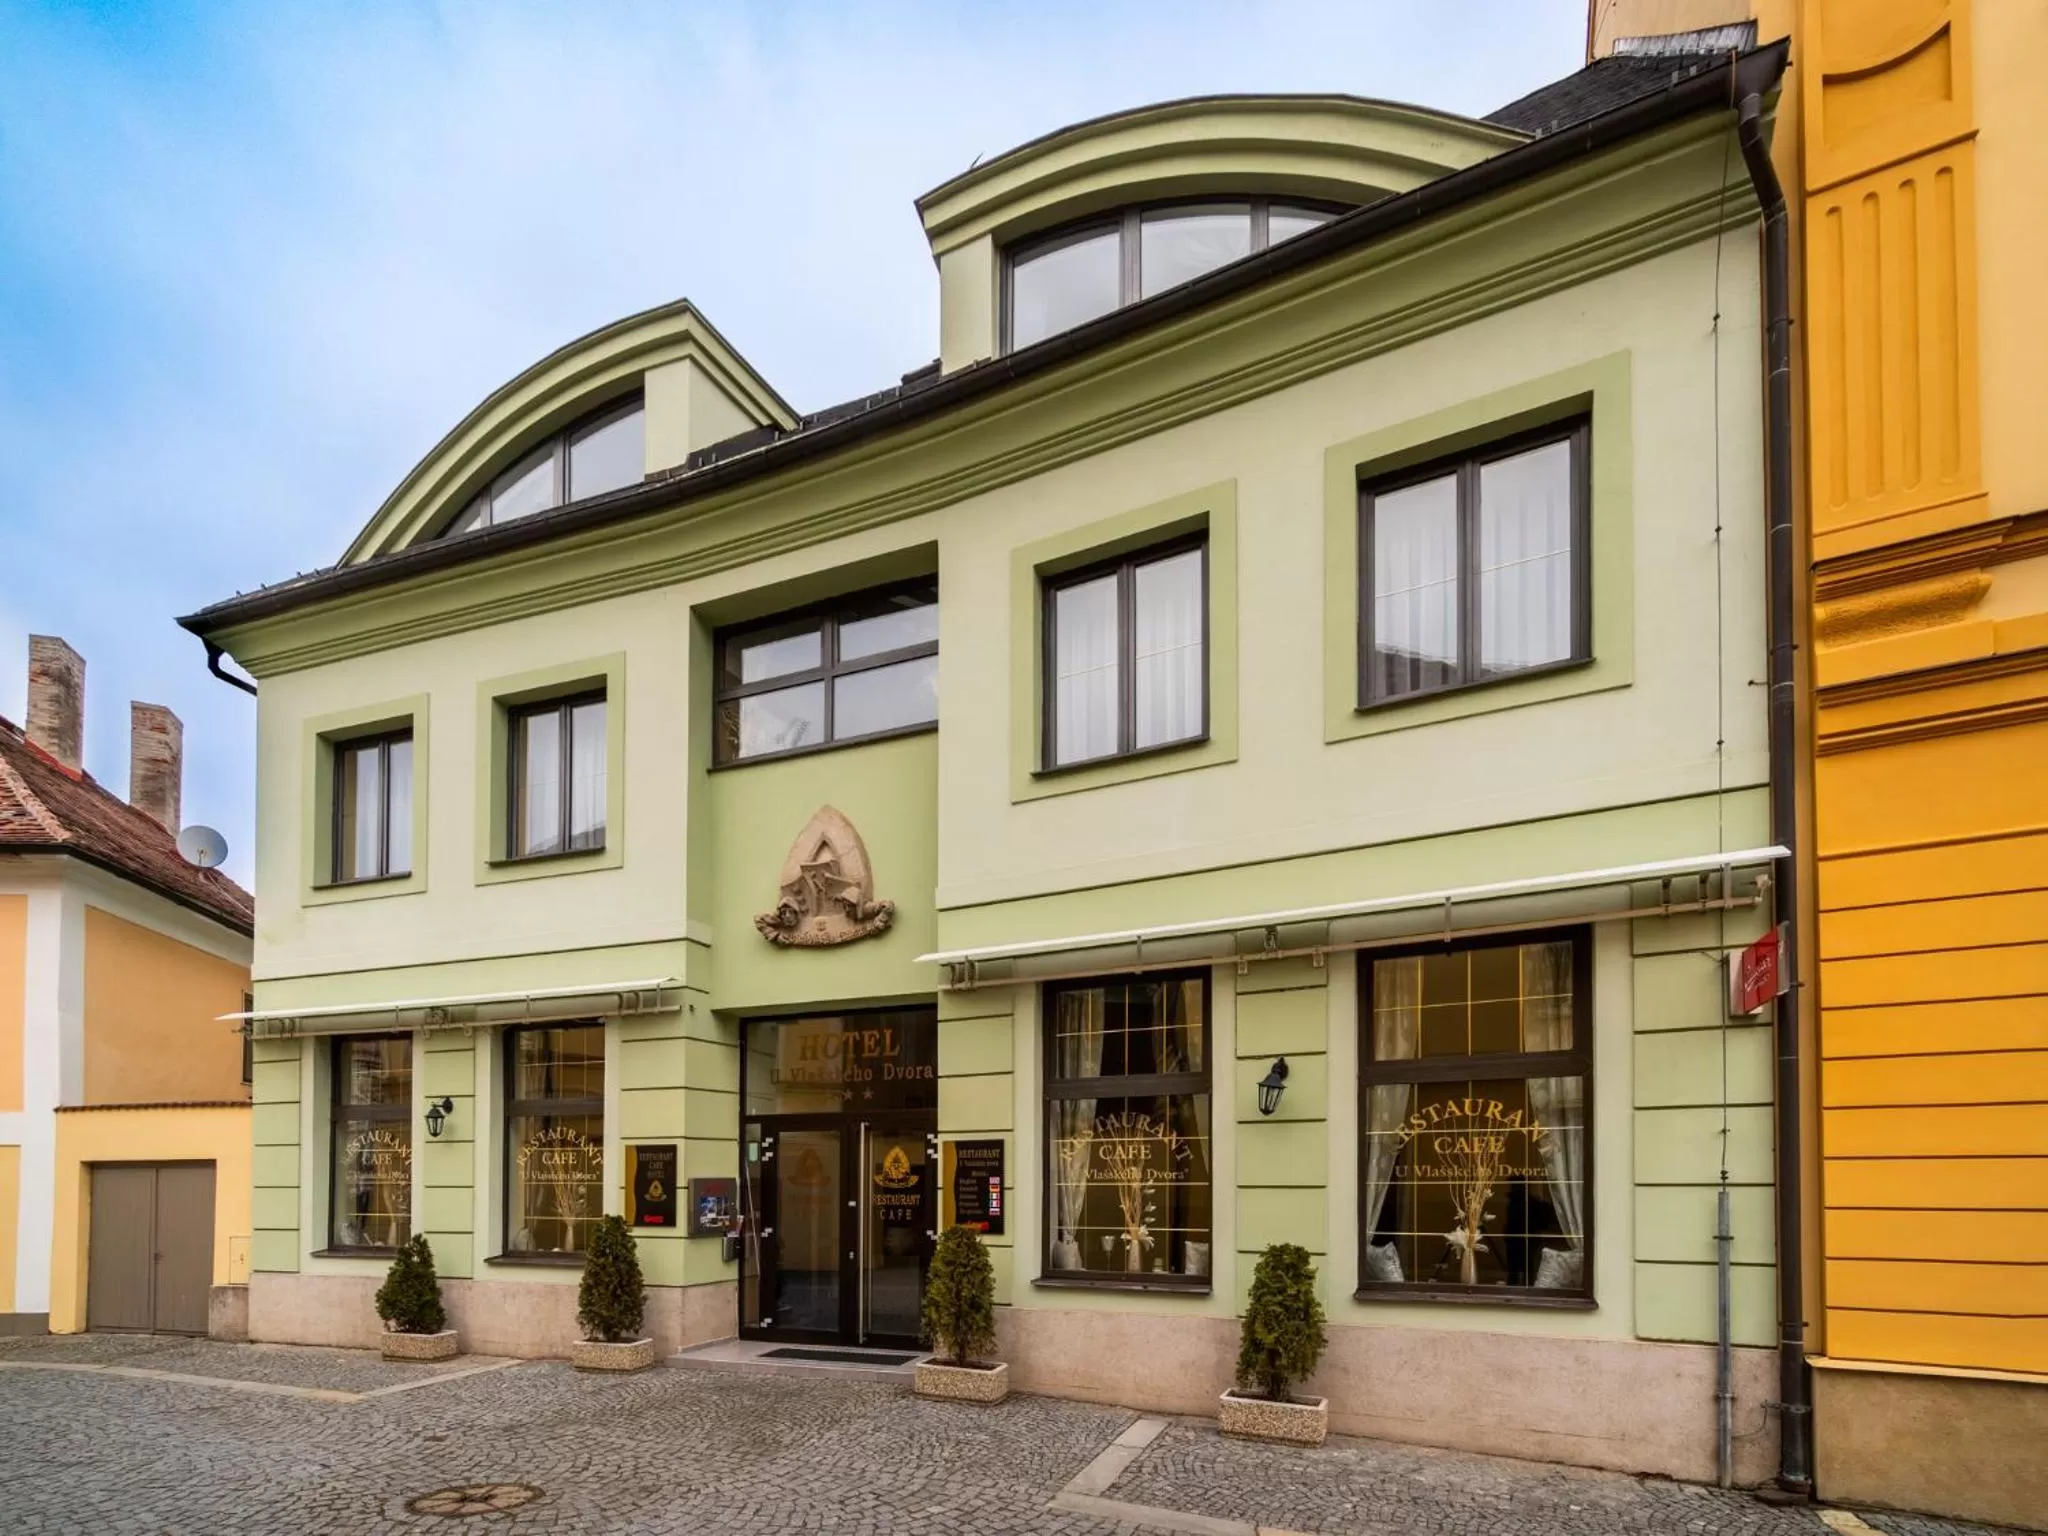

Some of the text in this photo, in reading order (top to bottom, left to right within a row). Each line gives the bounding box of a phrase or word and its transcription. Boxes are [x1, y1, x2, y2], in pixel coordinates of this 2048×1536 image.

[799, 1028, 900, 1061] HOTEL
[883, 1062, 934, 1081] Dvora
[516, 1126, 603, 1166] RESTAURANT
[1099, 1143, 1152, 1160] CAFE
[1433, 1136, 1506, 1153] CAFE
[542, 1150, 577, 1165] CAFE
[1395, 1165, 1409, 1178] U
[872, 1194, 921, 1206] RESTAURANT
